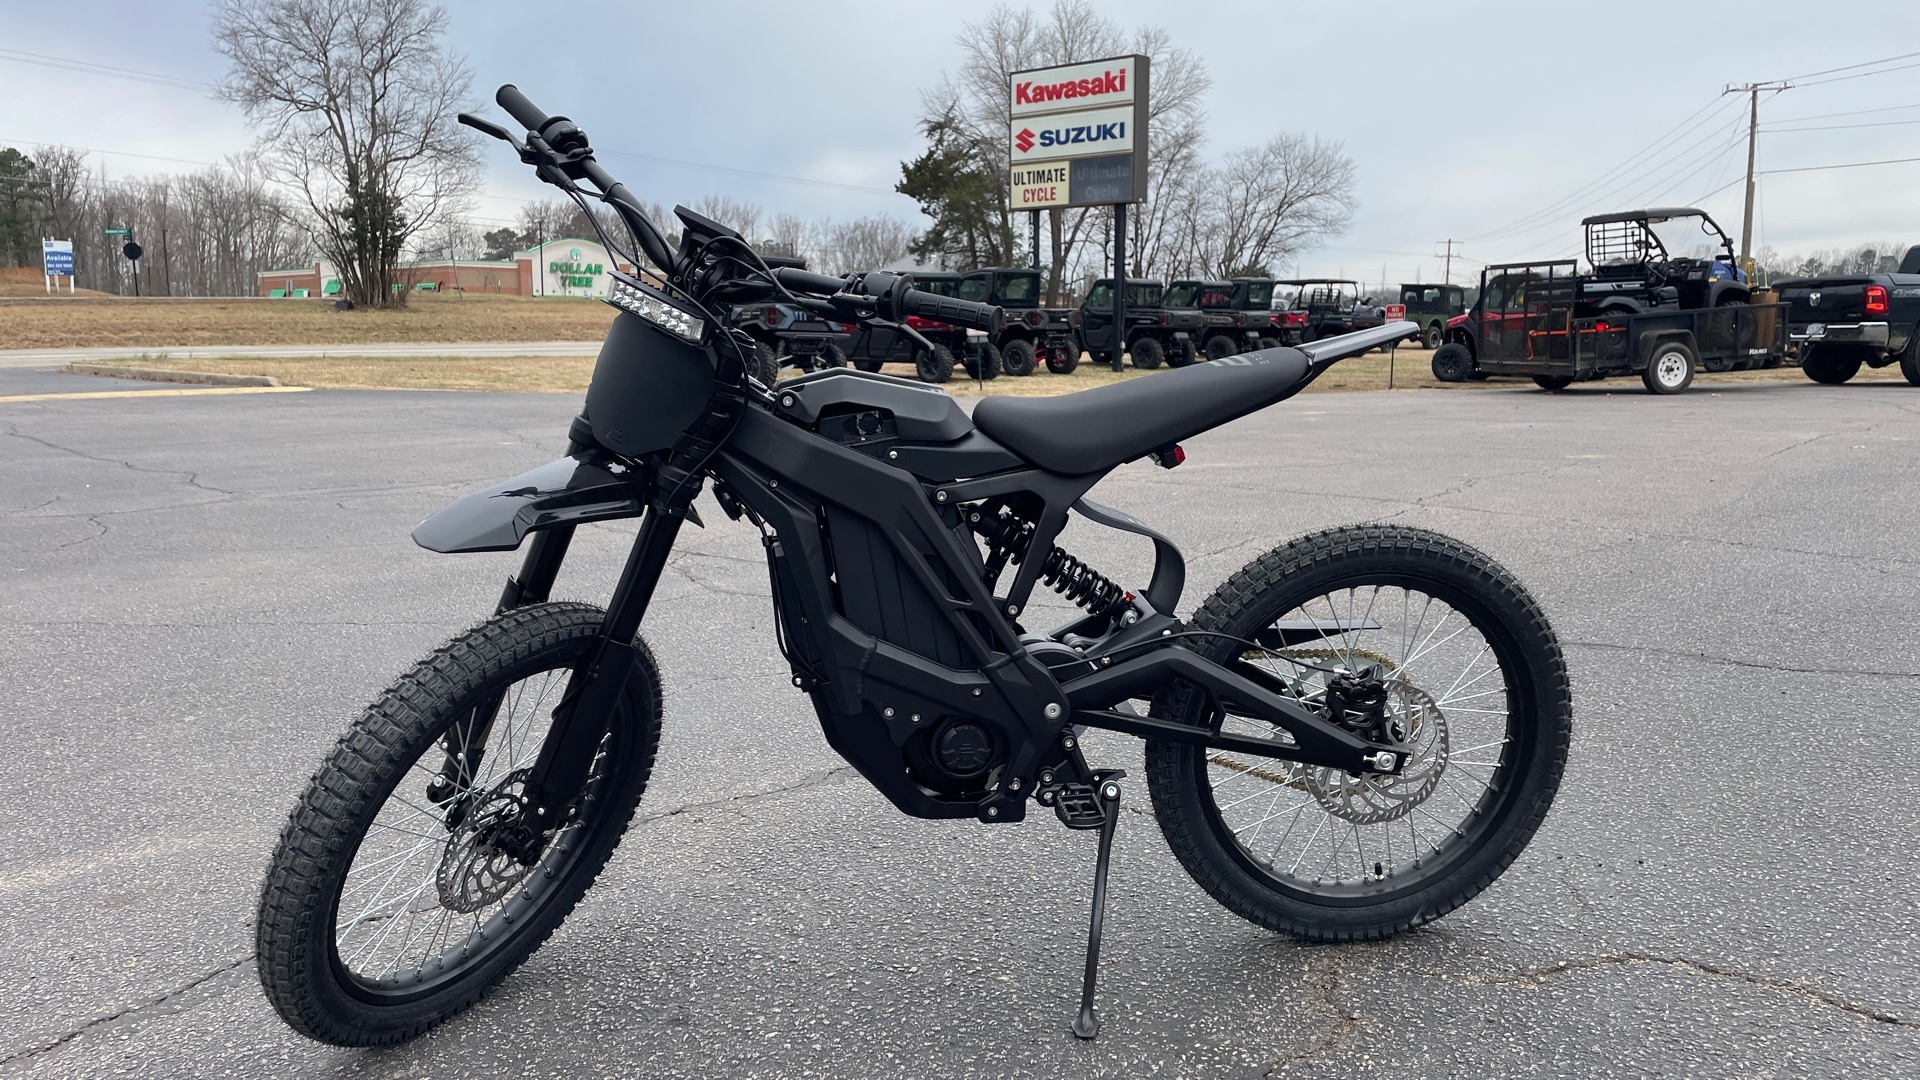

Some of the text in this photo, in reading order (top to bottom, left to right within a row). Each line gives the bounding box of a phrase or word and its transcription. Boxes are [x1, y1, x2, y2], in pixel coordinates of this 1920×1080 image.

[1016, 69, 1126, 105] Kawasaki
[1039, 122, 1125, 147] SUZUKI
[1013, 168, 1066, 186] ULTIMATE
[1076, 165, 1129, 181] Ultimate
[1023, 187, 1056, 203] CYCLE
[1085, 185, 1119, 200] Cycle
[550, 261, 603, 276] DOLLAR
[561, 275, 593, 287] TREE
